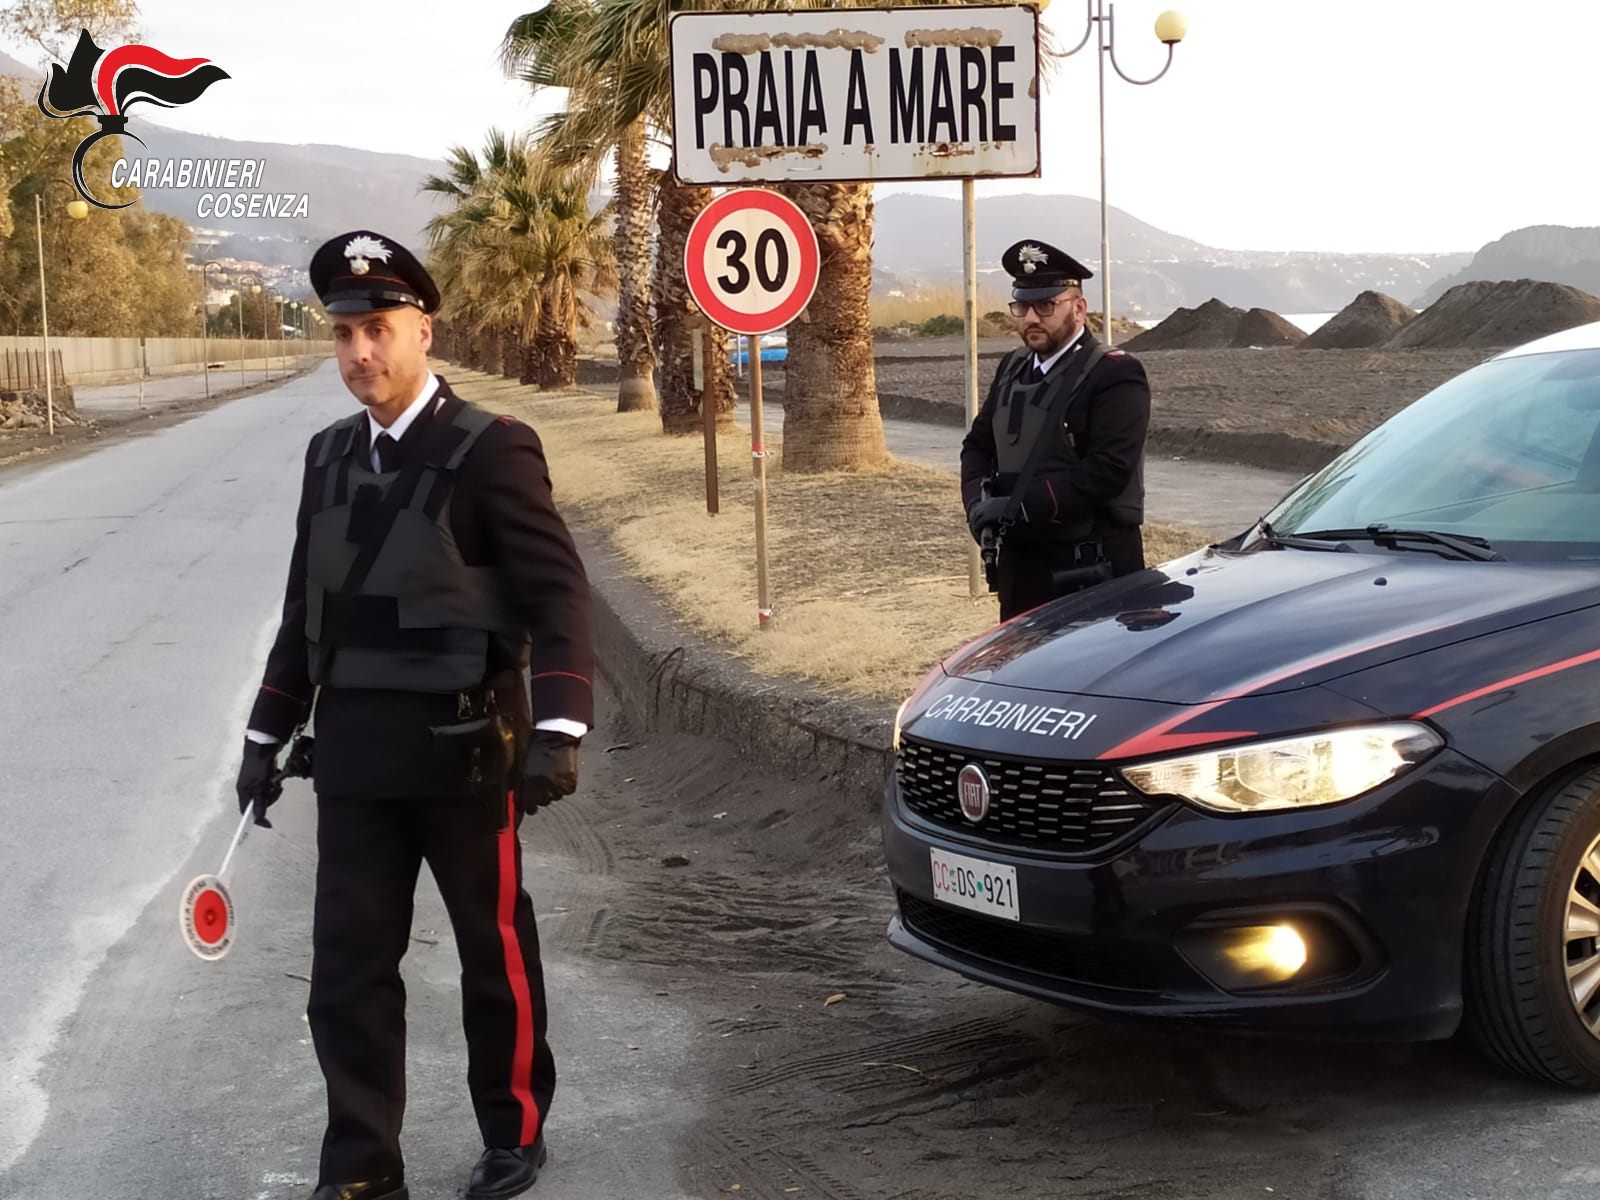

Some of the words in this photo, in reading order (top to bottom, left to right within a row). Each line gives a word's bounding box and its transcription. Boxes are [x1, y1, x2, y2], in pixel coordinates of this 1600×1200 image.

[692, 49, 828, 150] PRAIA
[843, 48, 874, 146] A
[888, 45, 1017, 145] MARE
[716, 227, 789, 295] 30
[924, 693, 1098, 741] CARABINIERI
[964, 781, 981, 808] FIAT
